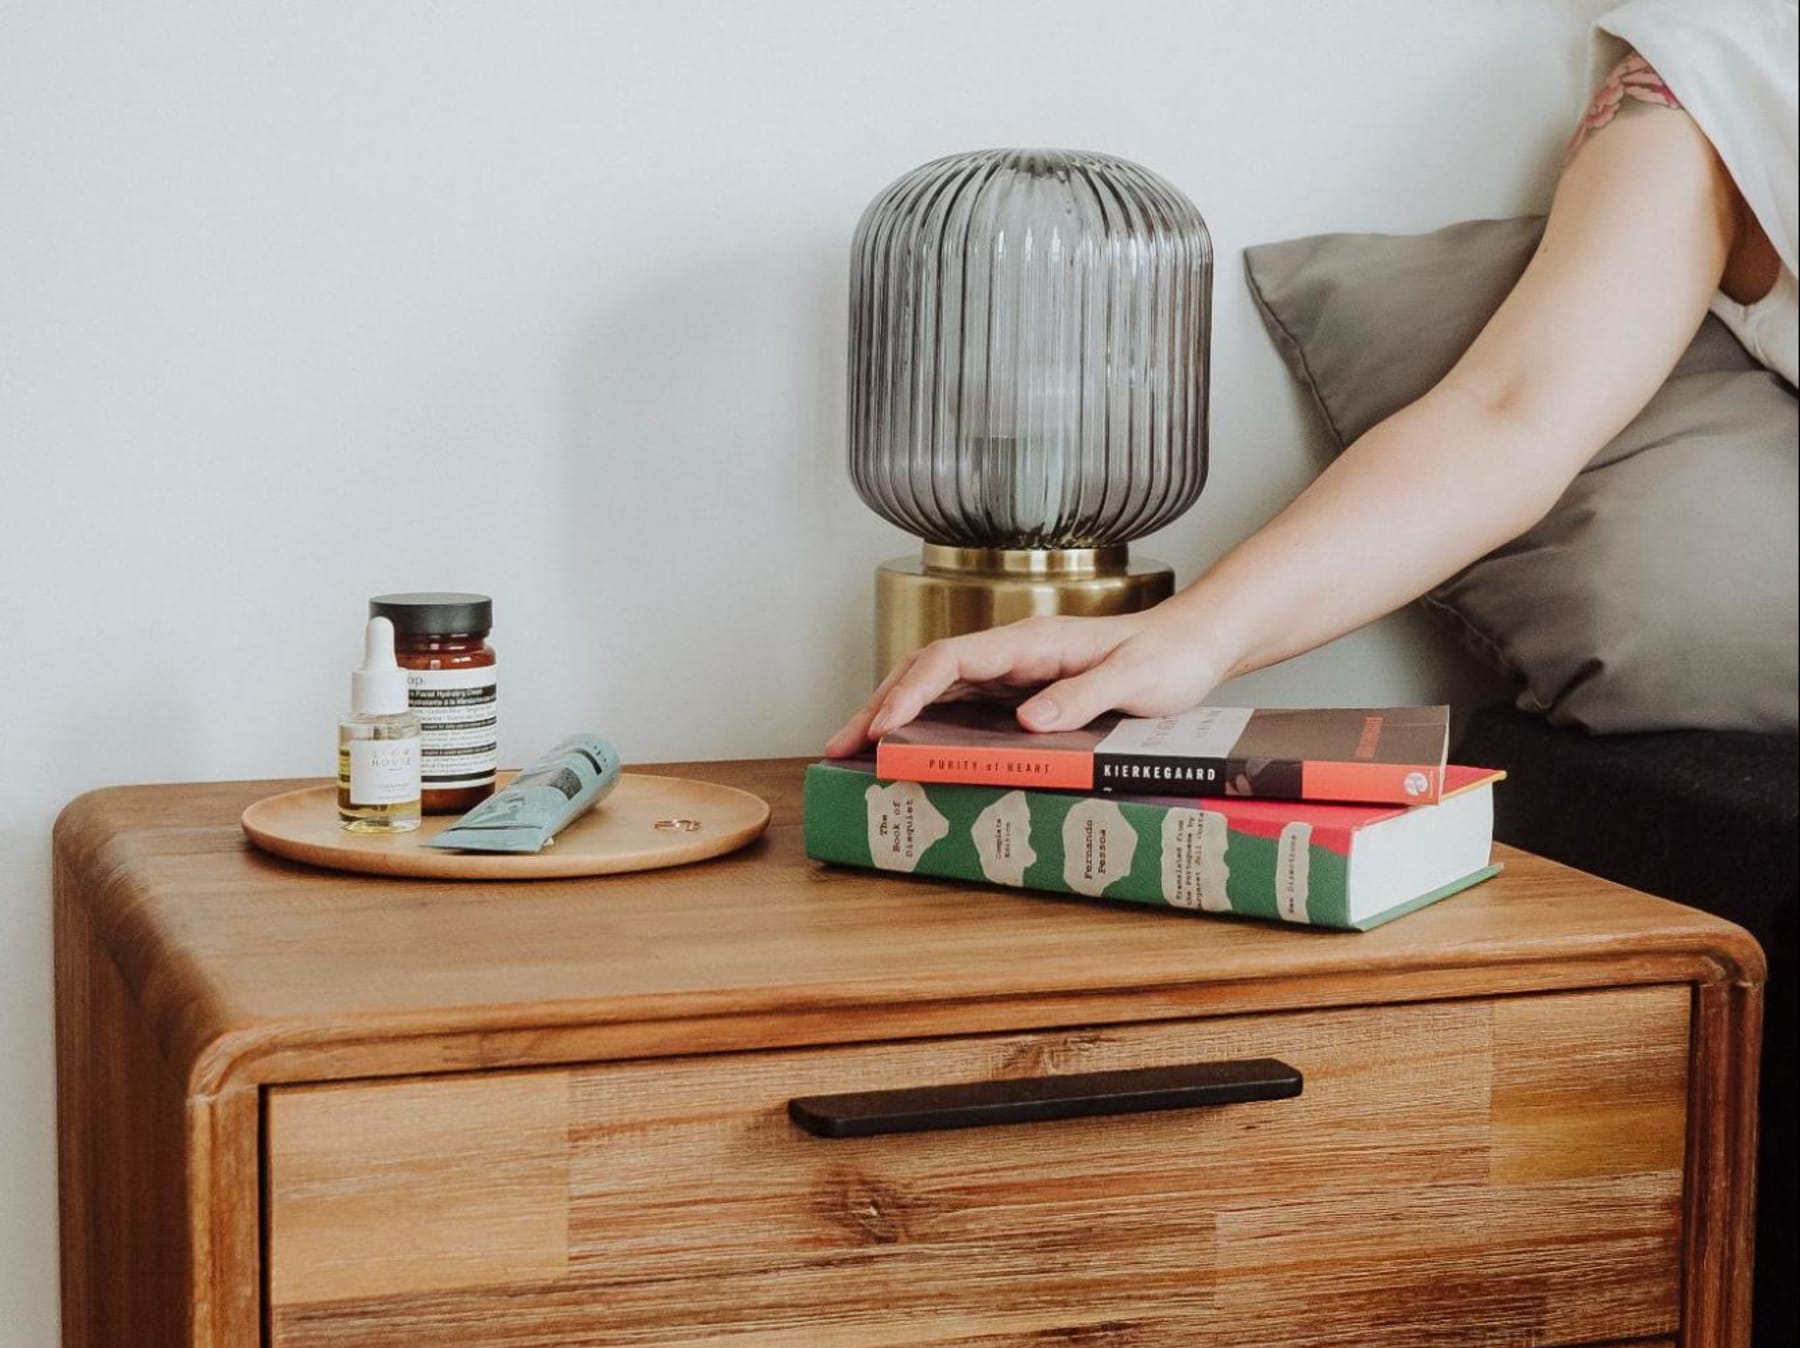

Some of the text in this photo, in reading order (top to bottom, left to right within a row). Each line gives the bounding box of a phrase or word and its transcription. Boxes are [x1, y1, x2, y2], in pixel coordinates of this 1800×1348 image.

[928, 759, 978, 771] PURITY
[1007, 762, 1050, 775] HEART
[1104, 765, 1216, 782] KIERKEGAARD
[879, 814, 888, 836] The
[893, 801, 901, 853] Book of
[905, 799, 915, 858] Disquiet
[994, 818, 1003, 861] Complete
[1187, 816, 1195, 828] by
[1084, 819, 1093, 880] Fernando
[1097, 829, 1106, 875] Pessoa
[1175, 820, 1184, 901] Translated from
[1287, 834, 1296, 893] Directions
